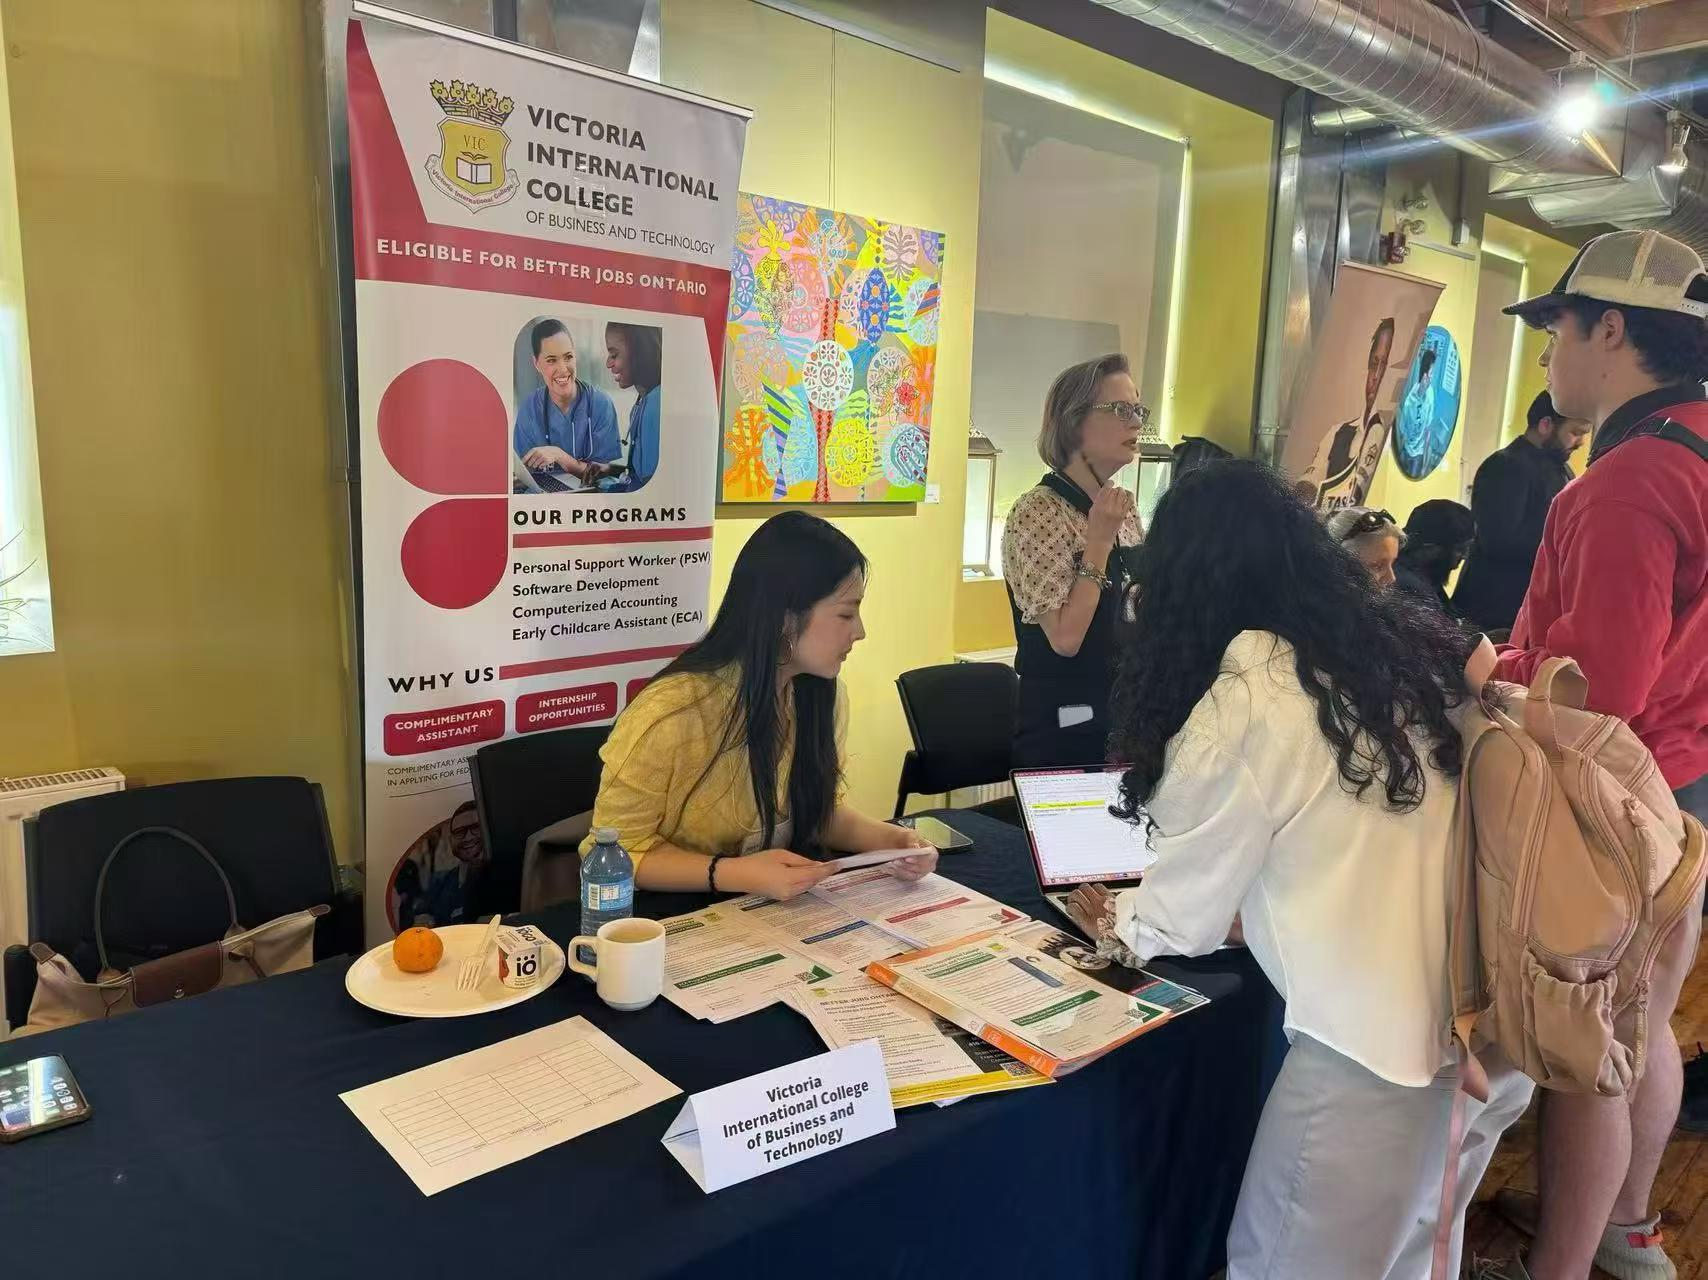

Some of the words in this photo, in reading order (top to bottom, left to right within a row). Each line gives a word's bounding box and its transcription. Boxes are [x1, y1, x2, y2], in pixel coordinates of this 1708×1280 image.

[527, 104, 646, 151] VICTORIA
[464, 135, 487, 151] VIC
[527, 140, 719, 202] INTERNATIONAL
[432, 169, 454, 192] Victoria
[454, 190, 493, 205] International
[494, 184, 514, 199] College
[526, 179, 634, 216] COLLEGE
[526, 210, 546, 226] OF
[549, 213, 605, 236] BUSINESS
[608, 222, 637, 241] AND
[641, 228, 715, 256] TECHNOLOGY
[376, 238, 472, 264] ELIGIBLE
[479, 251, 517, 270] FOR
[523, 257, 591, 280] BETTER
[595, 266, 634, 287] JOBS
[639, 273, 708, 296] ONTARIO
[513, 509, 562, 526] OUR
[571, 507, 687, 524] PROGRAMS
[513, 560, 571, 575] Personal
[574, 556, 625, 573] Support
[628, 554, 677, 568] Worker
[679, 551, 711, 569] (PSW)
[512, 582, 573, 597] Software
[576, 576, 660, 595] Development
[512, 600, 607, 620] Computerized
[610, 594, 679, 612] Accounting
[512, 626, 547, 642] Early
[550, 620, 611, 637] Childcare
[614, 614, 669, 630] Assistant
[671, 610, 703, 628] (ECA)
[388, 672, 454, 693] WHY
[465, 667, 495, 684] US
[528, 703, 606, 723] OPPORTUNITIES
[538, 692, 598, 709] INTERNSHIP
[394, 707, 494, 731] COMPLIMENTARY
[416, 724, 479, 743] ASSISTANT
[387, 758, 455, 775] COMPLIMENTARY
[399, 774, 438, 785] APPLYING
[440, 770, 454, 778] FOR
[766, 1075, 822, 1103] Victoria
[722, 1096, 819, 1139] International
[821, 1079, 869, 1106] College
[747, 1131, 762, 1151] of
[764, 1117, 827, 1145] Business
[829, 1102, 855, 1123] and
[763, 1126, 844, 1163] Technology
